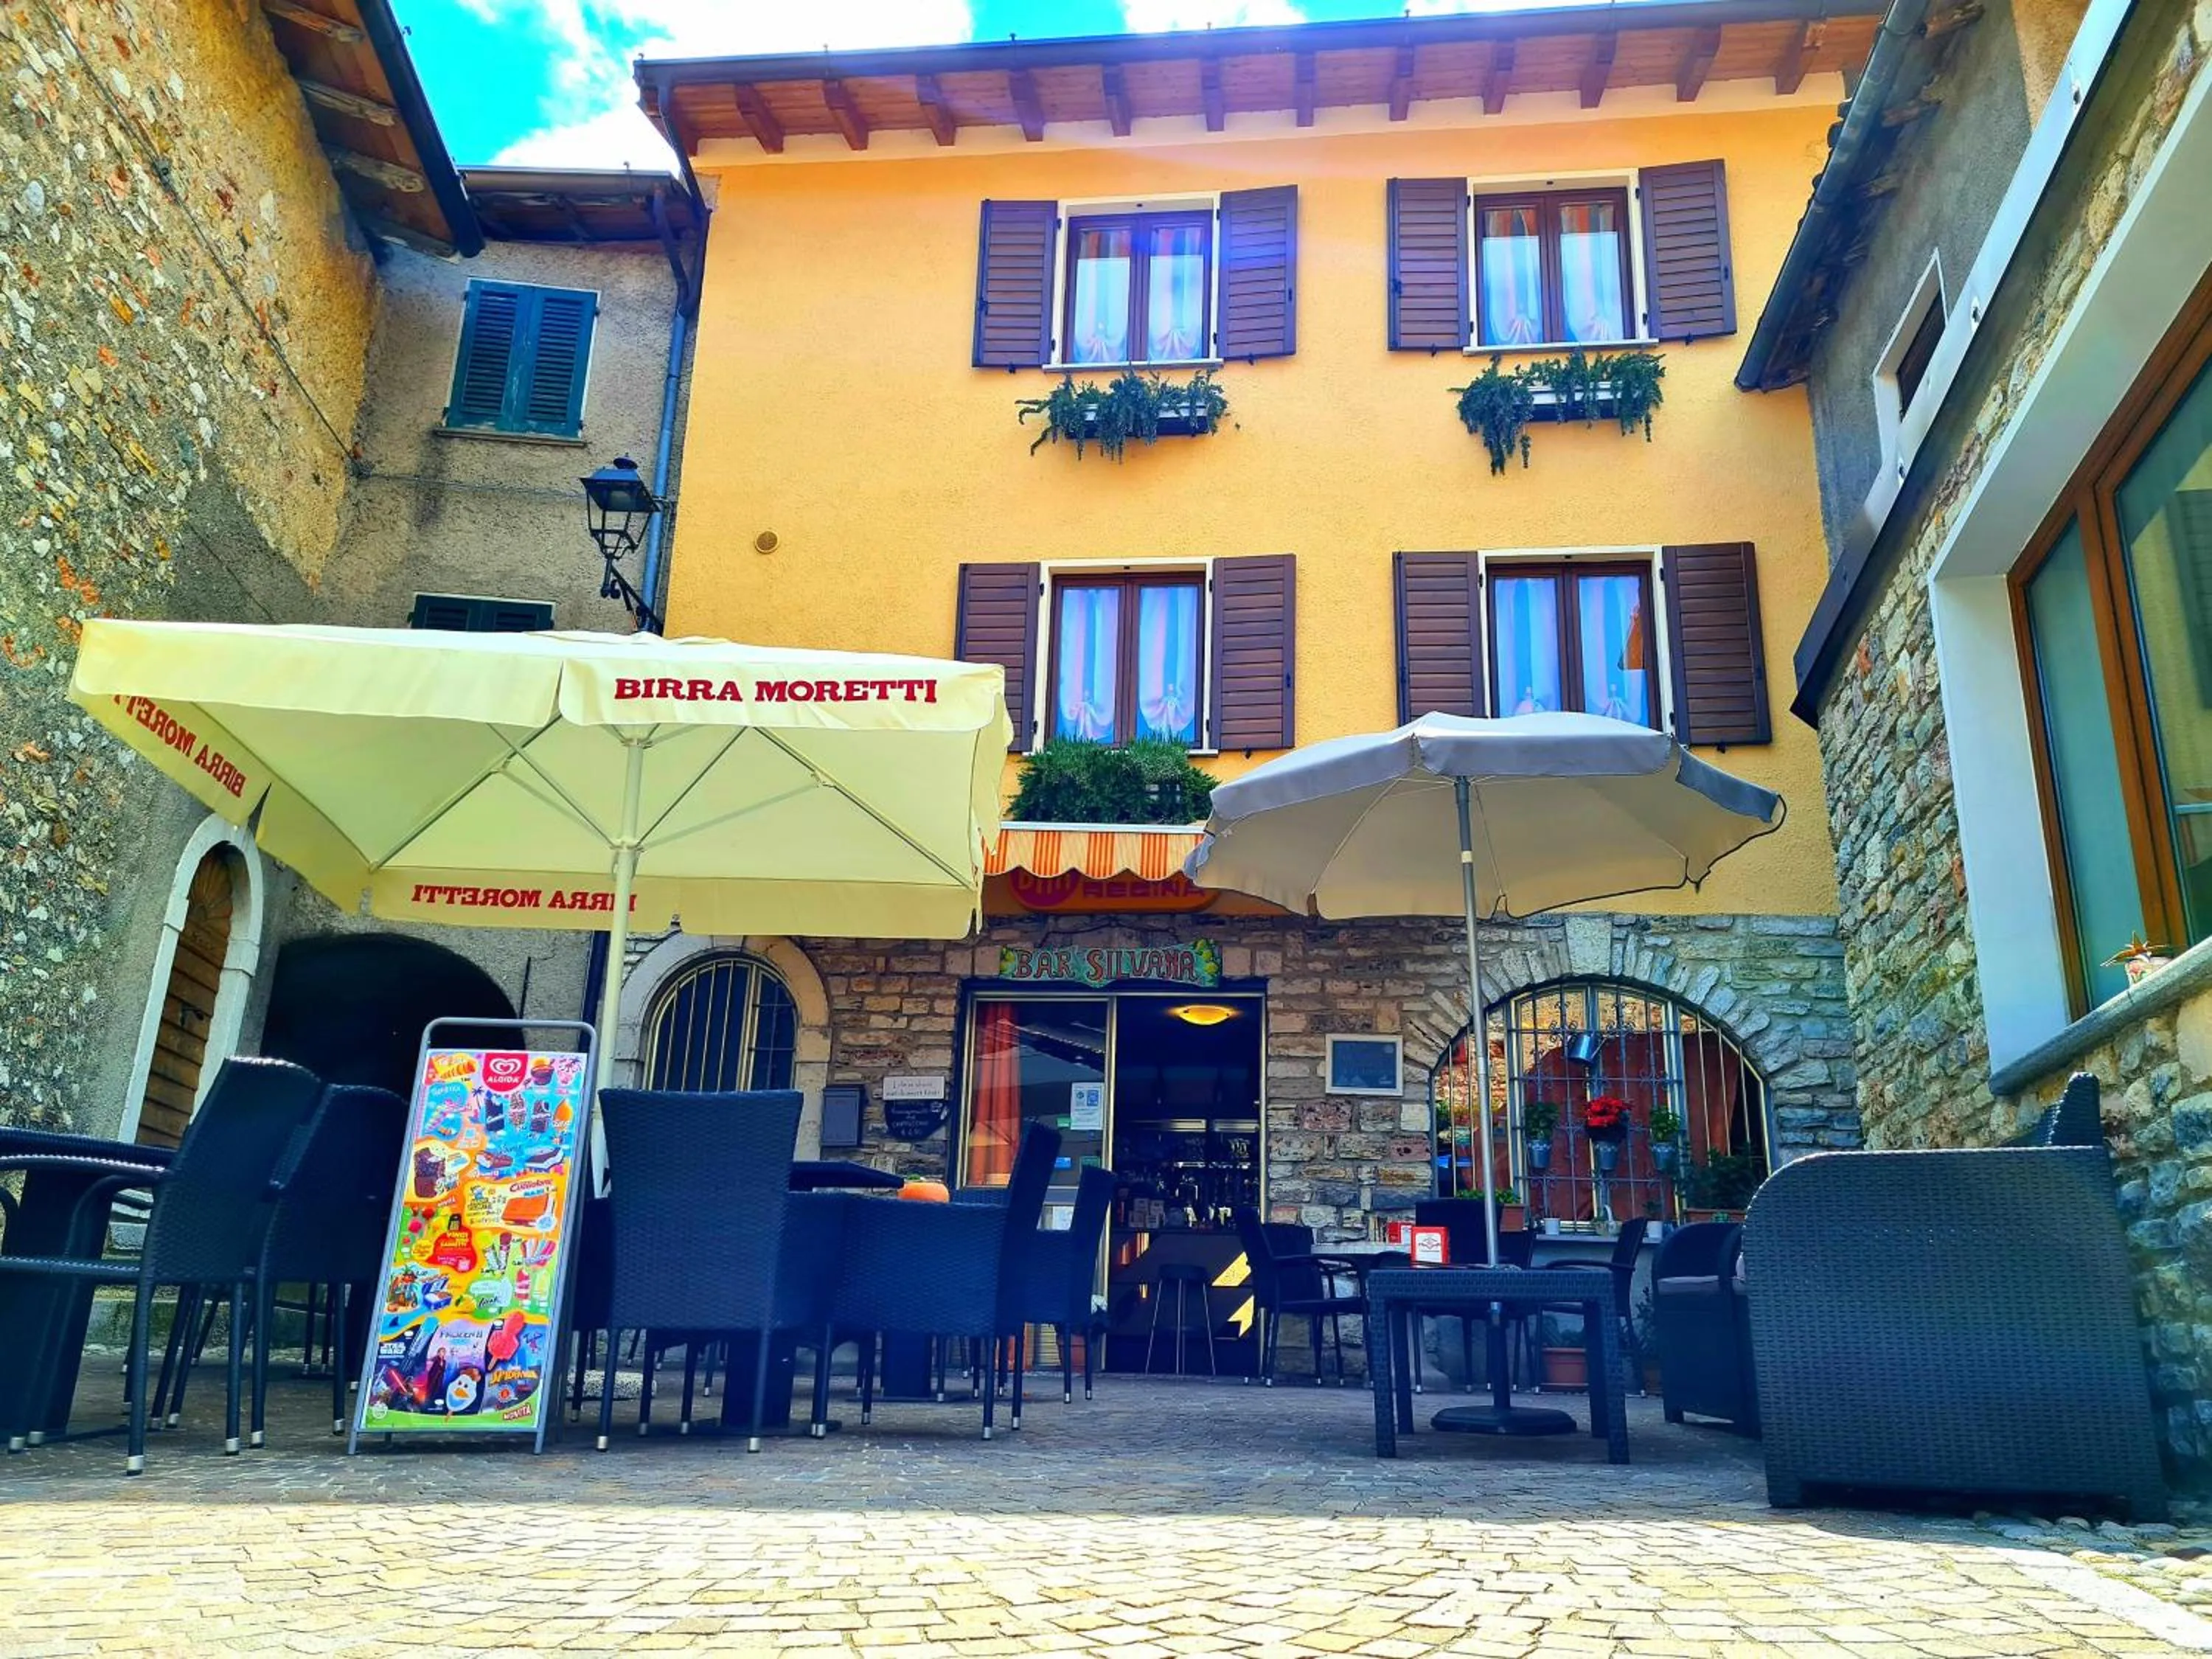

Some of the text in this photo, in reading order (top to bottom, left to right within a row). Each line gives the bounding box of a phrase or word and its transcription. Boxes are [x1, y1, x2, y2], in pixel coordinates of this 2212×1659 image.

[614, 678, 938, 704] BIRRA MORETTI
[1013, 949, 1200, 983] BAR SILVANA
[487, 1076, 520, 1084] ALGIDA
